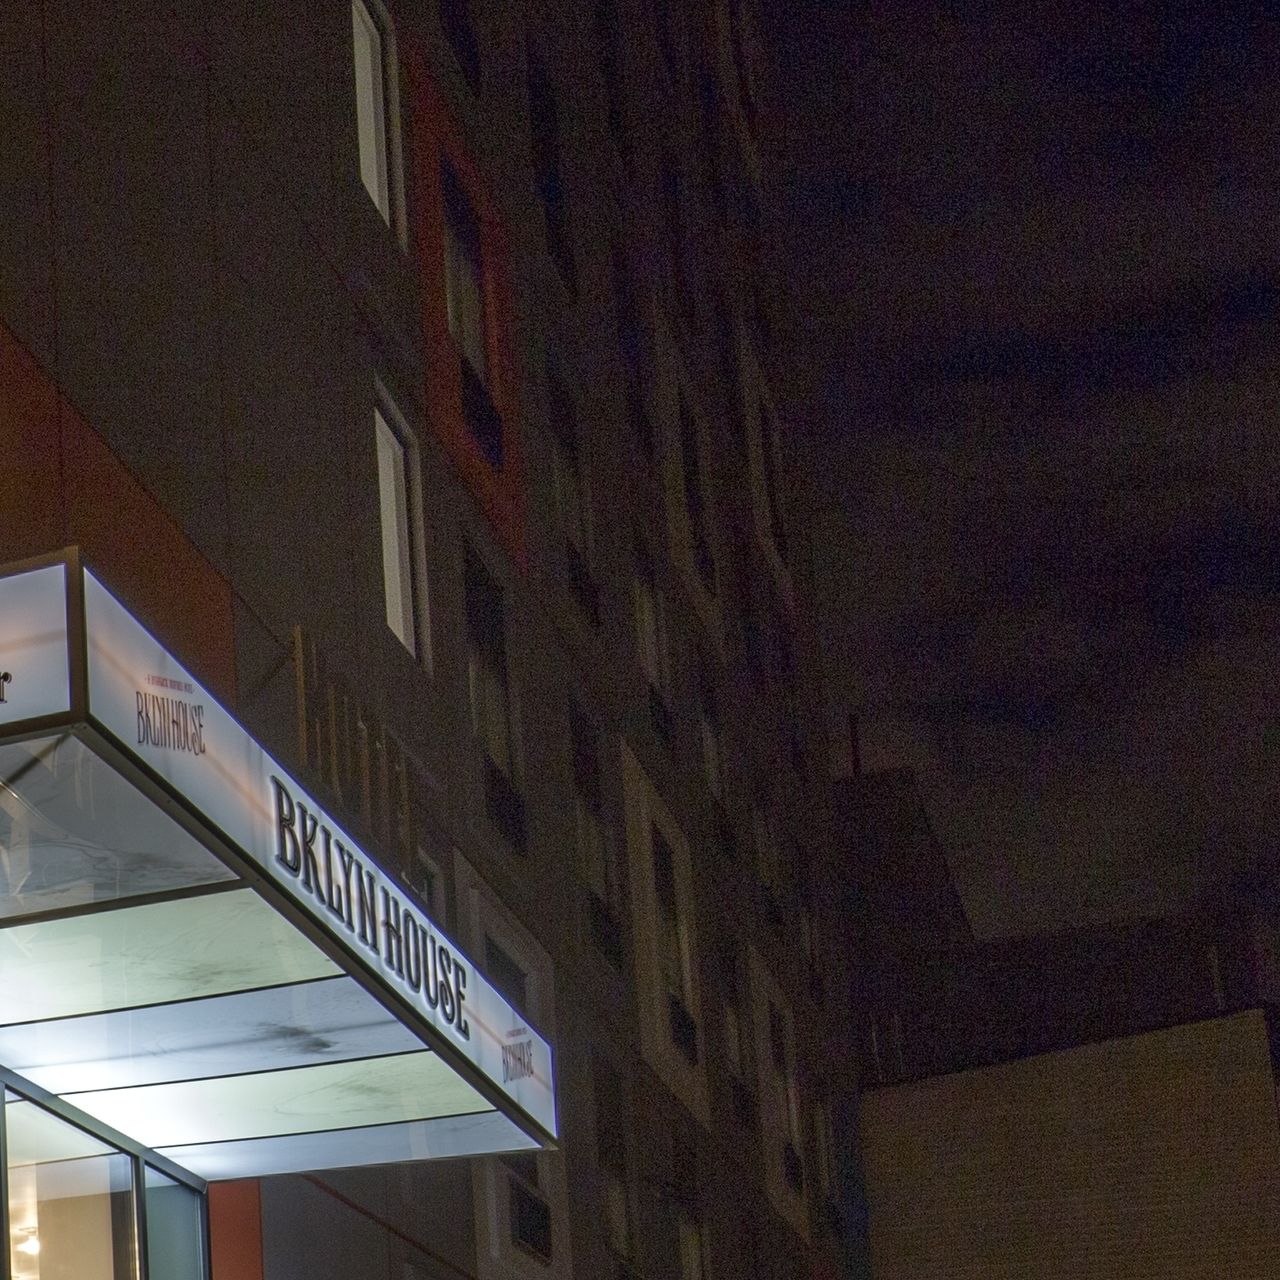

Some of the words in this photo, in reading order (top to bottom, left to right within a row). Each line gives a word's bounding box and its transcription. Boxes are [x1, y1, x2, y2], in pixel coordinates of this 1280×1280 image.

[171, 698, 206, 756] HOUSE
[271, 775, 380, 956] BKLYN
[379, 885, 471, 1041] HOUSE
